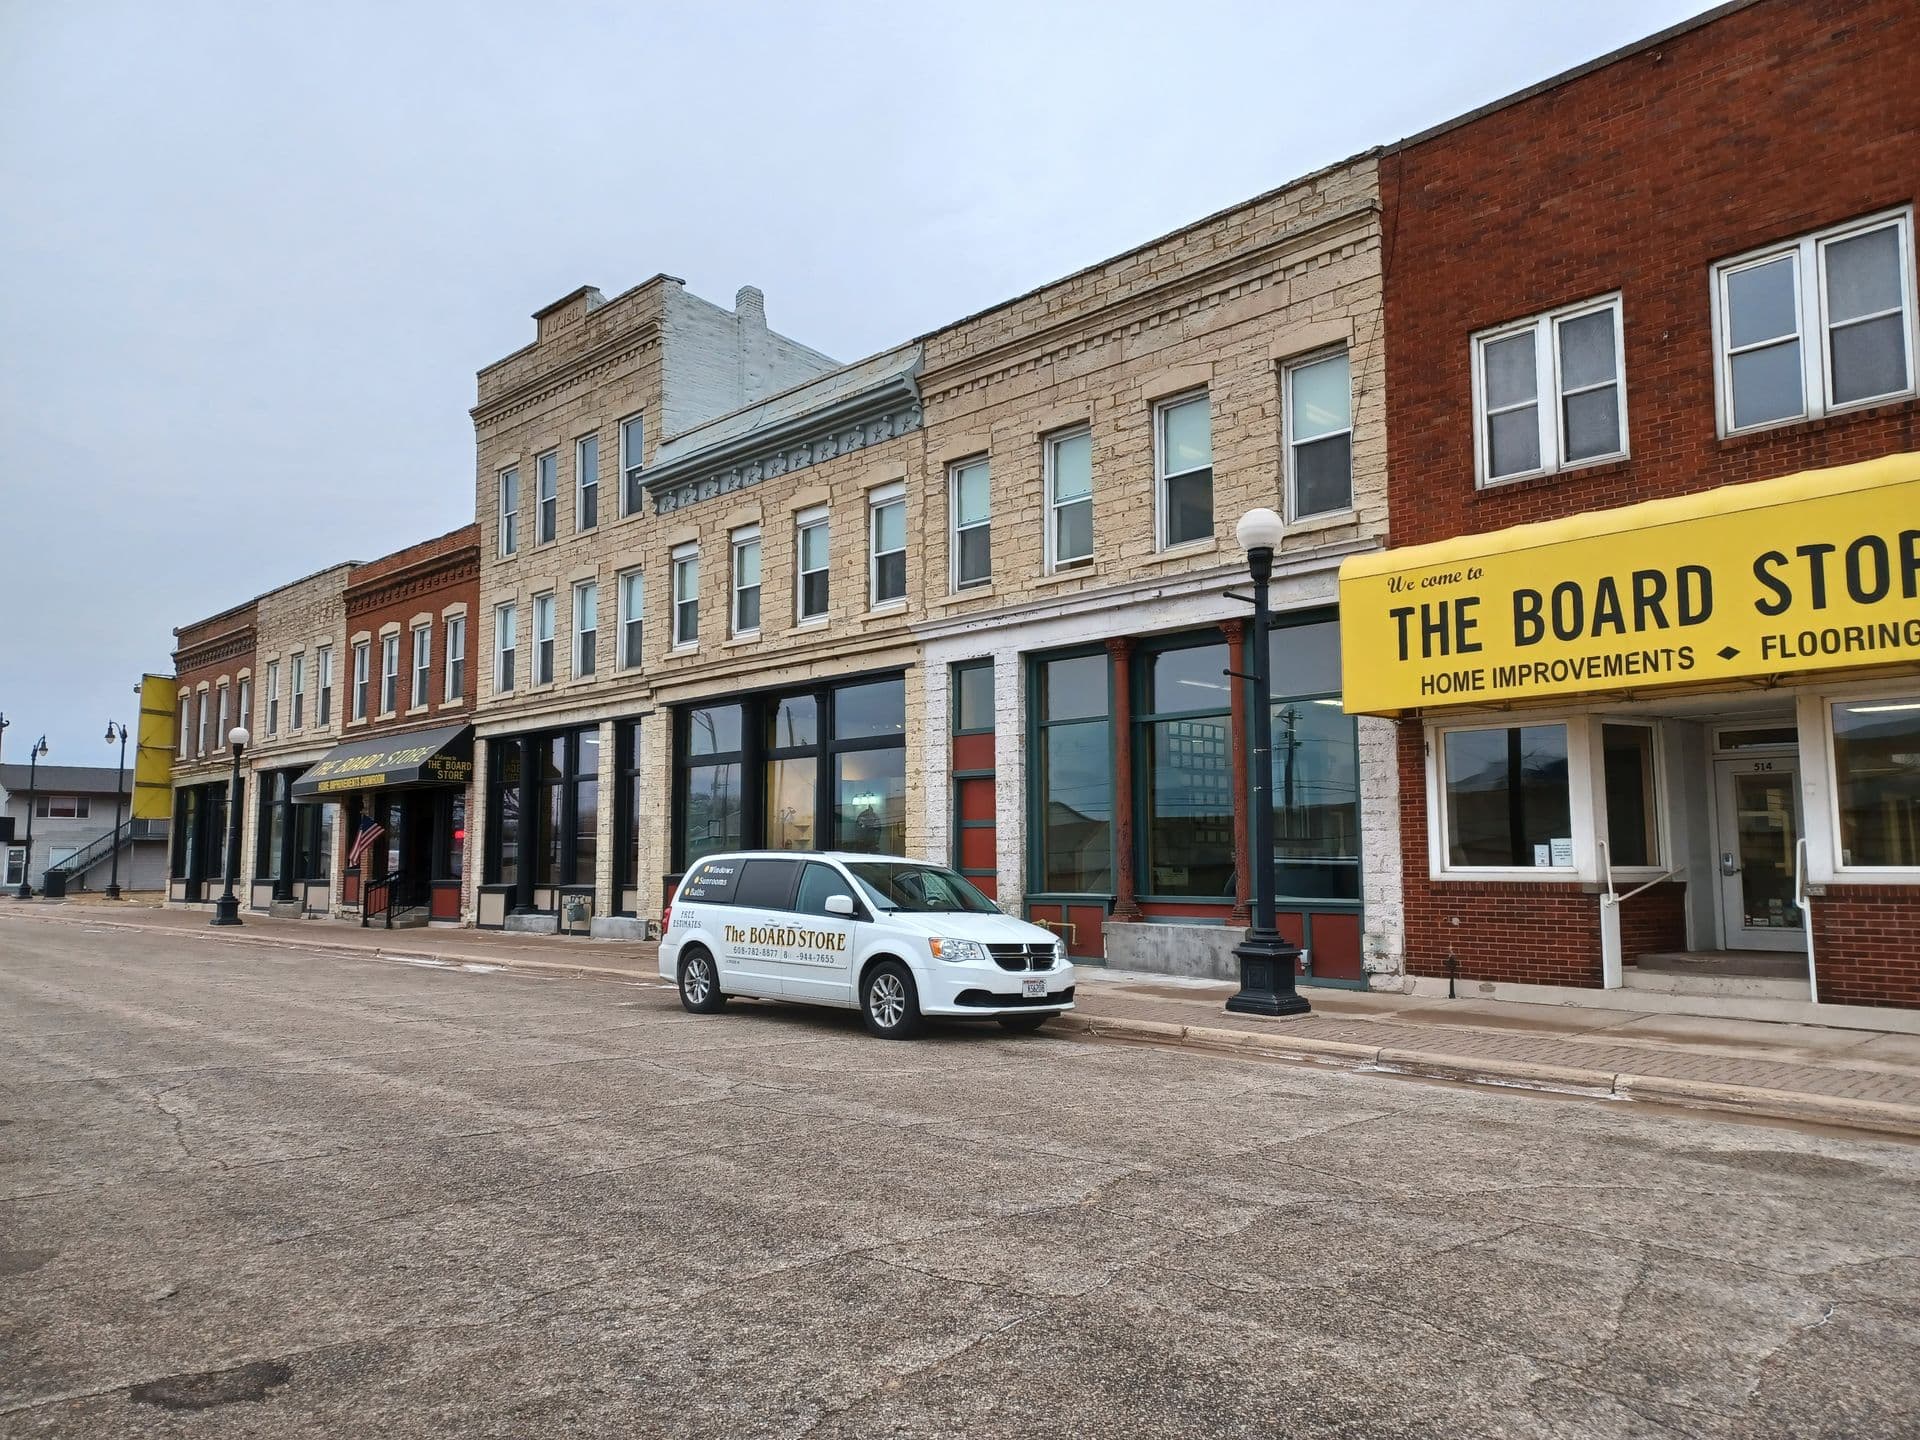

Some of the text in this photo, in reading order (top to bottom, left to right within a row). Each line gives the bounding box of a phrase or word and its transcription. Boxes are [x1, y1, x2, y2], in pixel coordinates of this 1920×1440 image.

[1421, 571, 1463, 588] come
[1467, 567, 1484, 580] to
[1390, 596, 1482, 661] THE
[1512, 565, 1713, 647] BOARD
[1421, 619, 1920, 695] HOME IMPROVEMENTS FLOORING
[309, 745, 436, 777] THE BOARD STORE
[428, 760, 472, 770] THE BOARD
[1753, 762, 1772, 770] 514
[437, 770, 464, 780] STORE
[709, 866, 734, 874] Windows
[698, 877, 728, 886] Sunrooms
[680, 911, 695, 919] FREE
[673, 920, 702, 929] ESTIMATES
[725, 925, 746, 943] The
[733, 946, 778, 958] 608-782-8877
